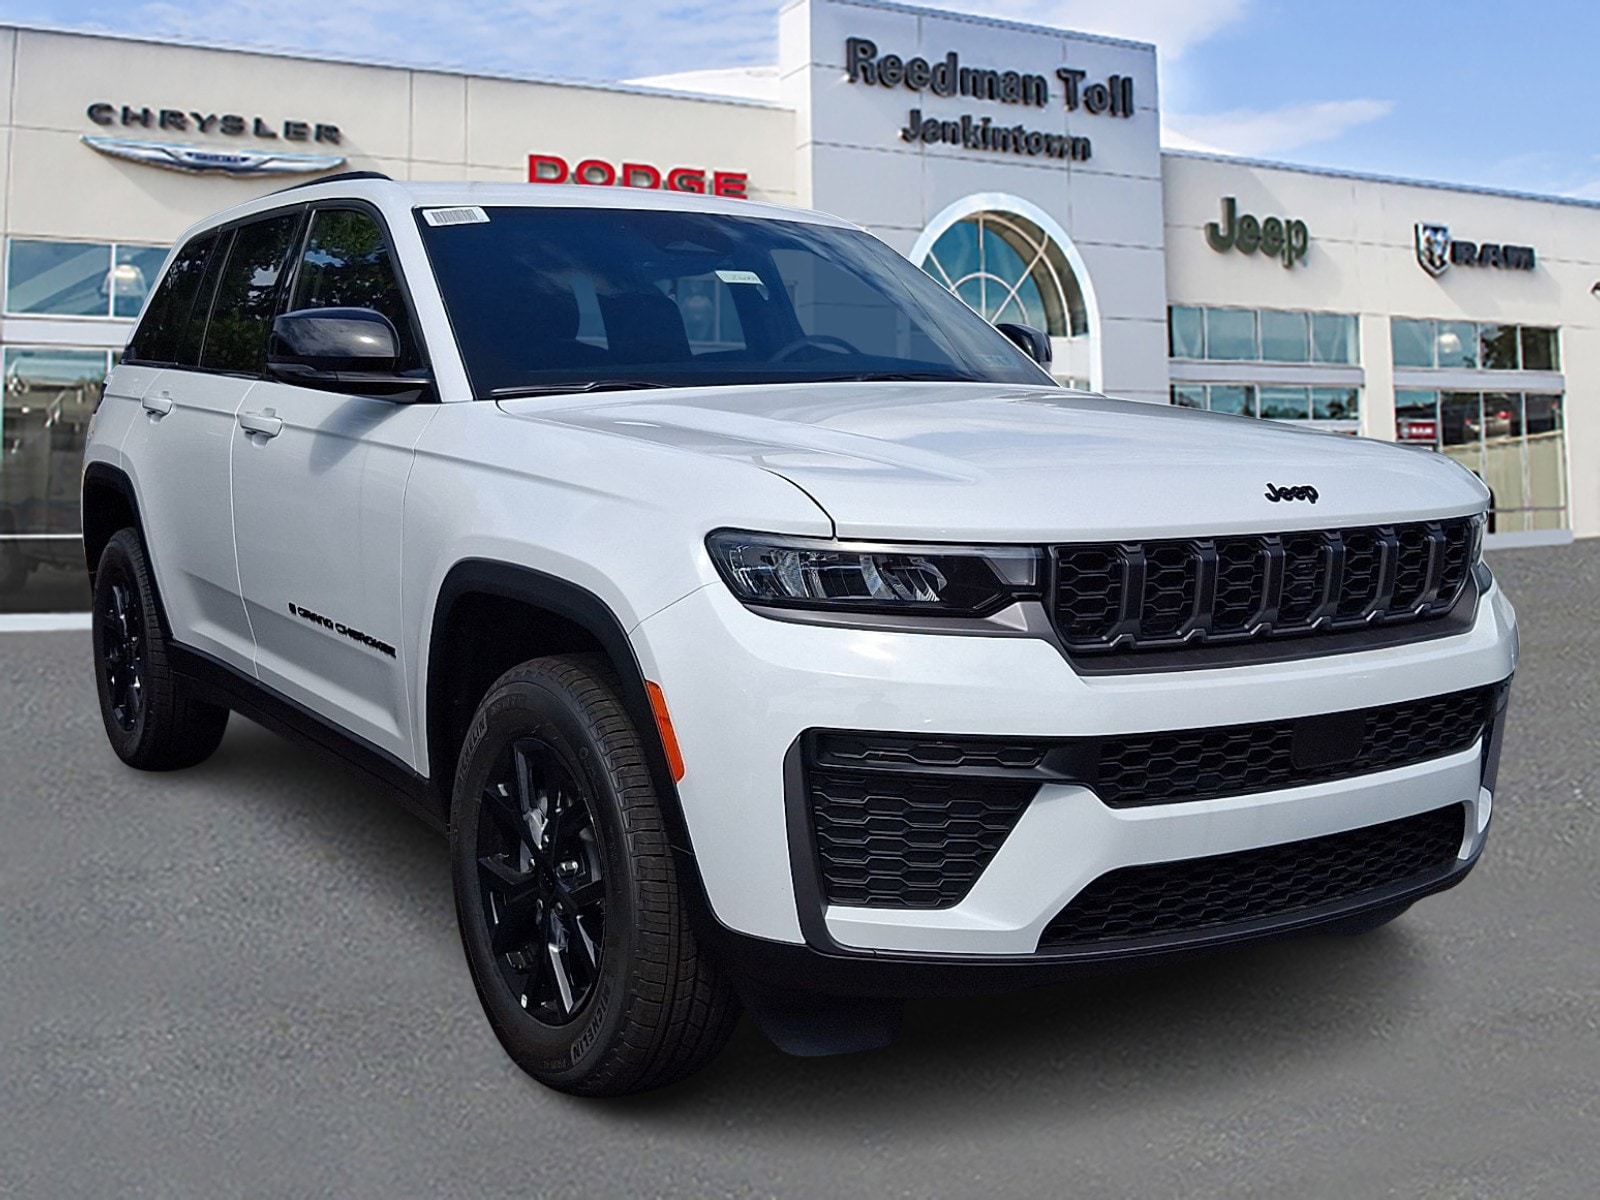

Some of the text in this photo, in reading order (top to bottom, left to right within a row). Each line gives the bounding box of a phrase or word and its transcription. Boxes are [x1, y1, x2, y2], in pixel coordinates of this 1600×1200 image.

[846, 37, 1135, 118] Reedman Toll
[87, 102, 341, 145] CHRYSLER
[901, 109, 1092, 161] Jenkintown
[528, 154, 748, 200] DODGE
[1204, 196, 1308, 270] Jeep
[1450, 241, 1536, 271] RAM
[1264, 482, 1319, 504] Jeep
